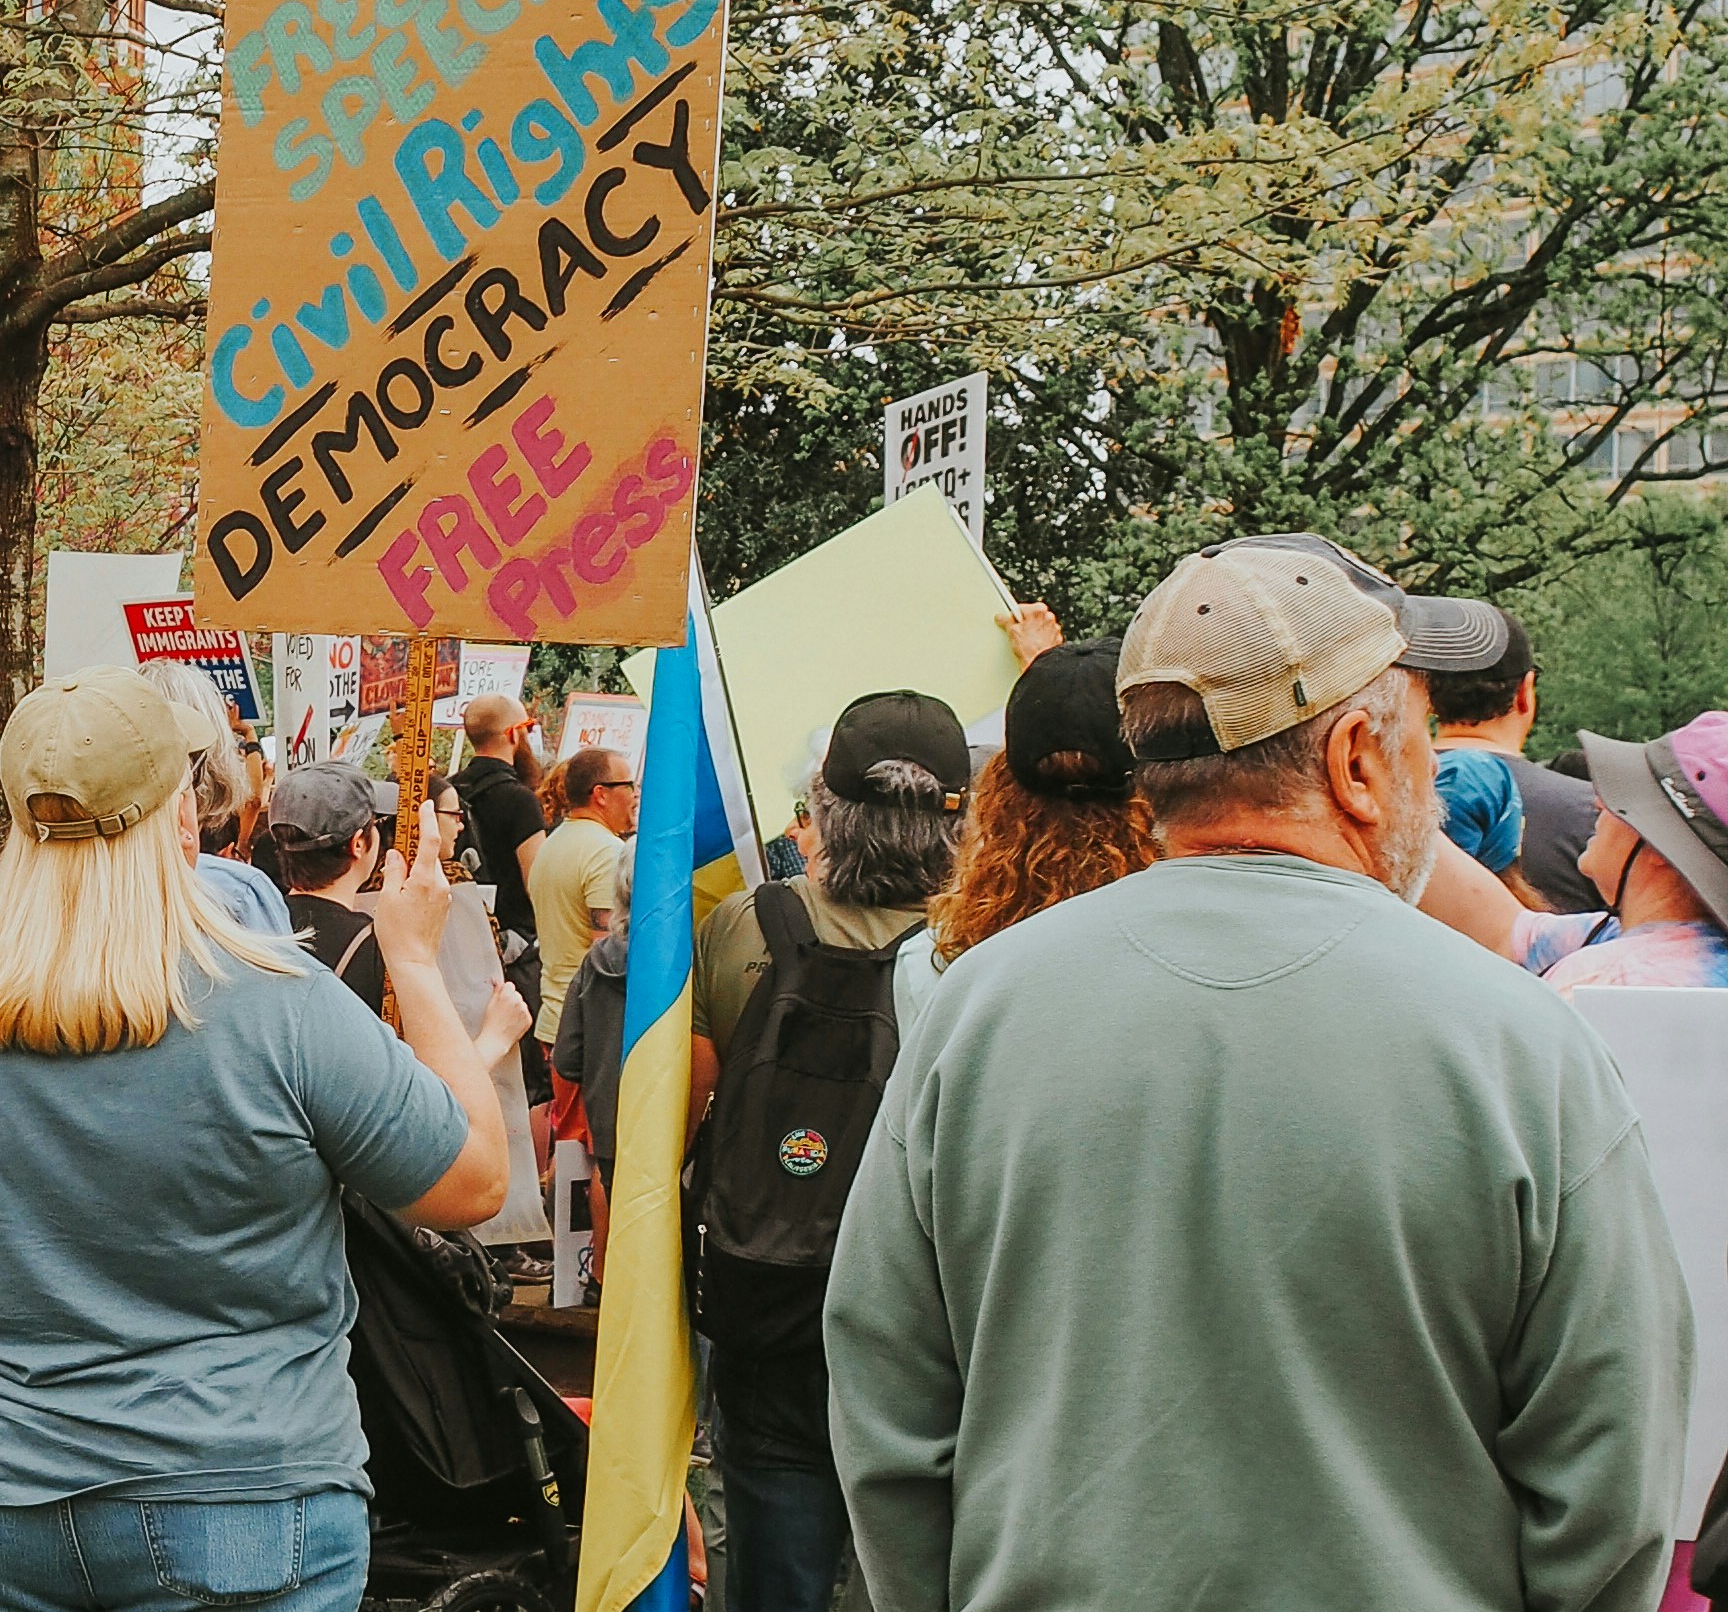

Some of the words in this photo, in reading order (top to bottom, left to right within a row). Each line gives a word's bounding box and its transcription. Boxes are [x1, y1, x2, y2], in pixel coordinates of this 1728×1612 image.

[210, 195, 418, 429] Civil
[207, 100, 711, 601] DEMOCRACY
[901, 388, 968, 431] HANDS
[901, 414, 967, 471] OFF!
[378, 394, 592, 629] FREE
[143, 606, 184, 628] KEEP
[136, 629, 237, 653] IMMIGRANTS
[213, 669, 247, 690] THE
[285, 666, 303, 692] FOR
[621, 713, 634, 728] IS
[416, 728, 428, 757] CLIP
[579, 726, 607, 745] NOT
[412, 768, 426, 812] PAPER
